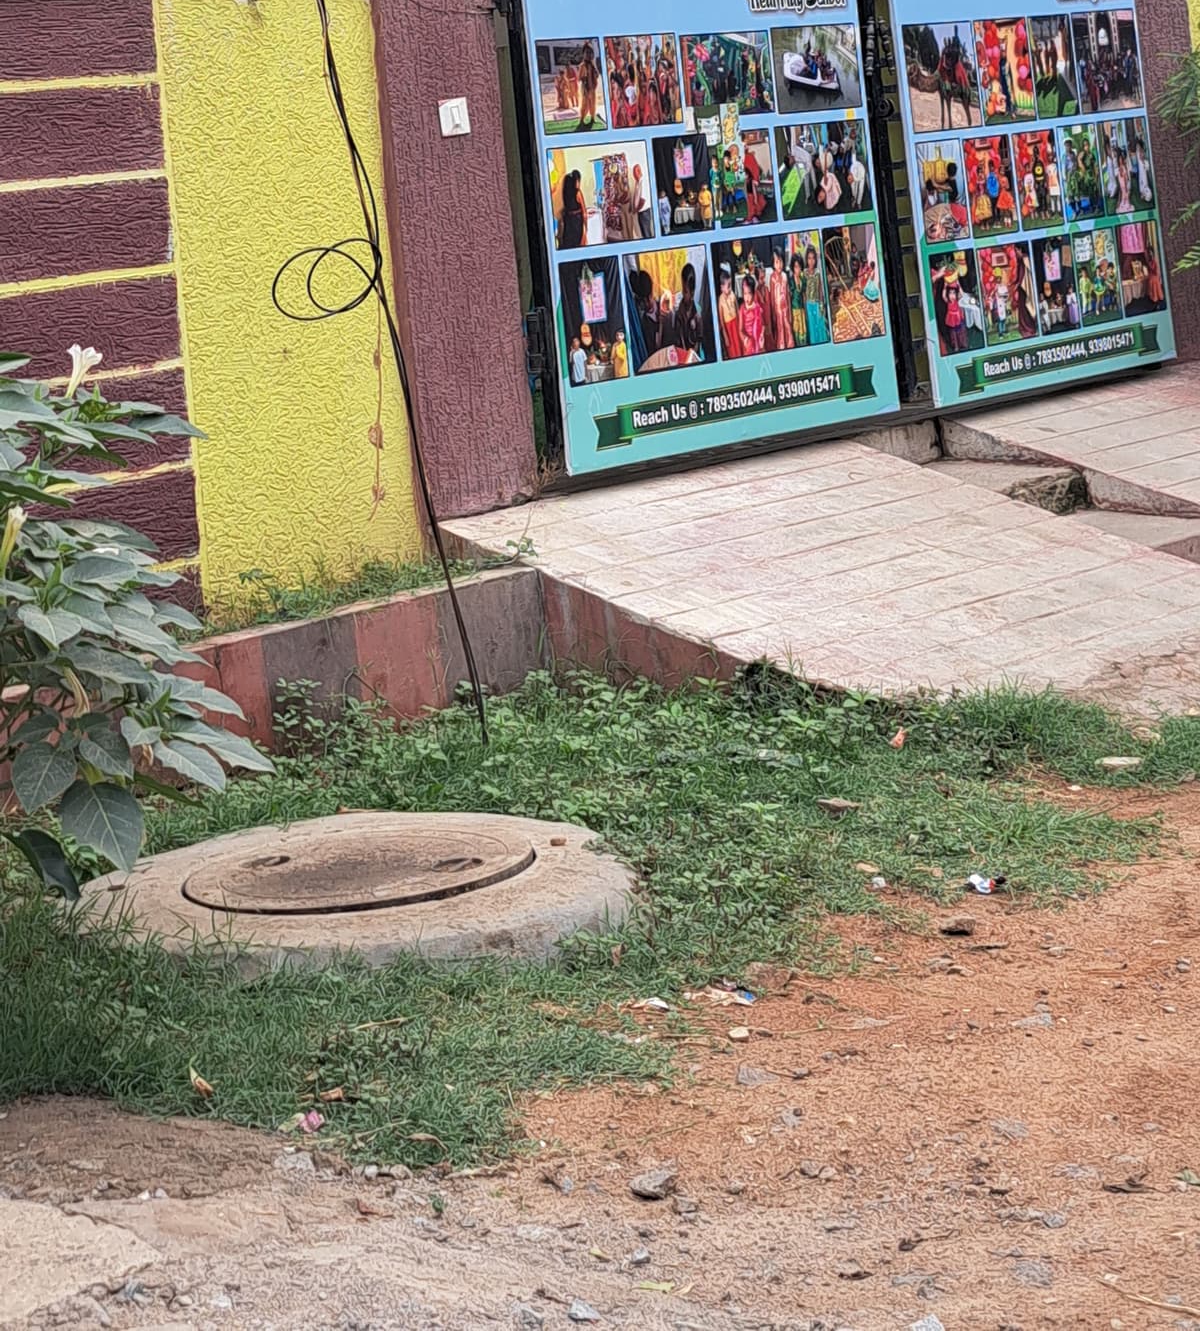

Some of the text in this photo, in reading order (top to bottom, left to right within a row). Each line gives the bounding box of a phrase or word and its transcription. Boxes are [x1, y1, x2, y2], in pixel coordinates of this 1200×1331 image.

[984, 361, 1011, 377] Reach
[1011, 356, 1024, 370] Us
[632, 409, 669, 428] Reach
[671, 403, 687, 420] Us
[706, 387, 776, 414] 7893502444,
[778, 373, 841, 400] 9398015471
